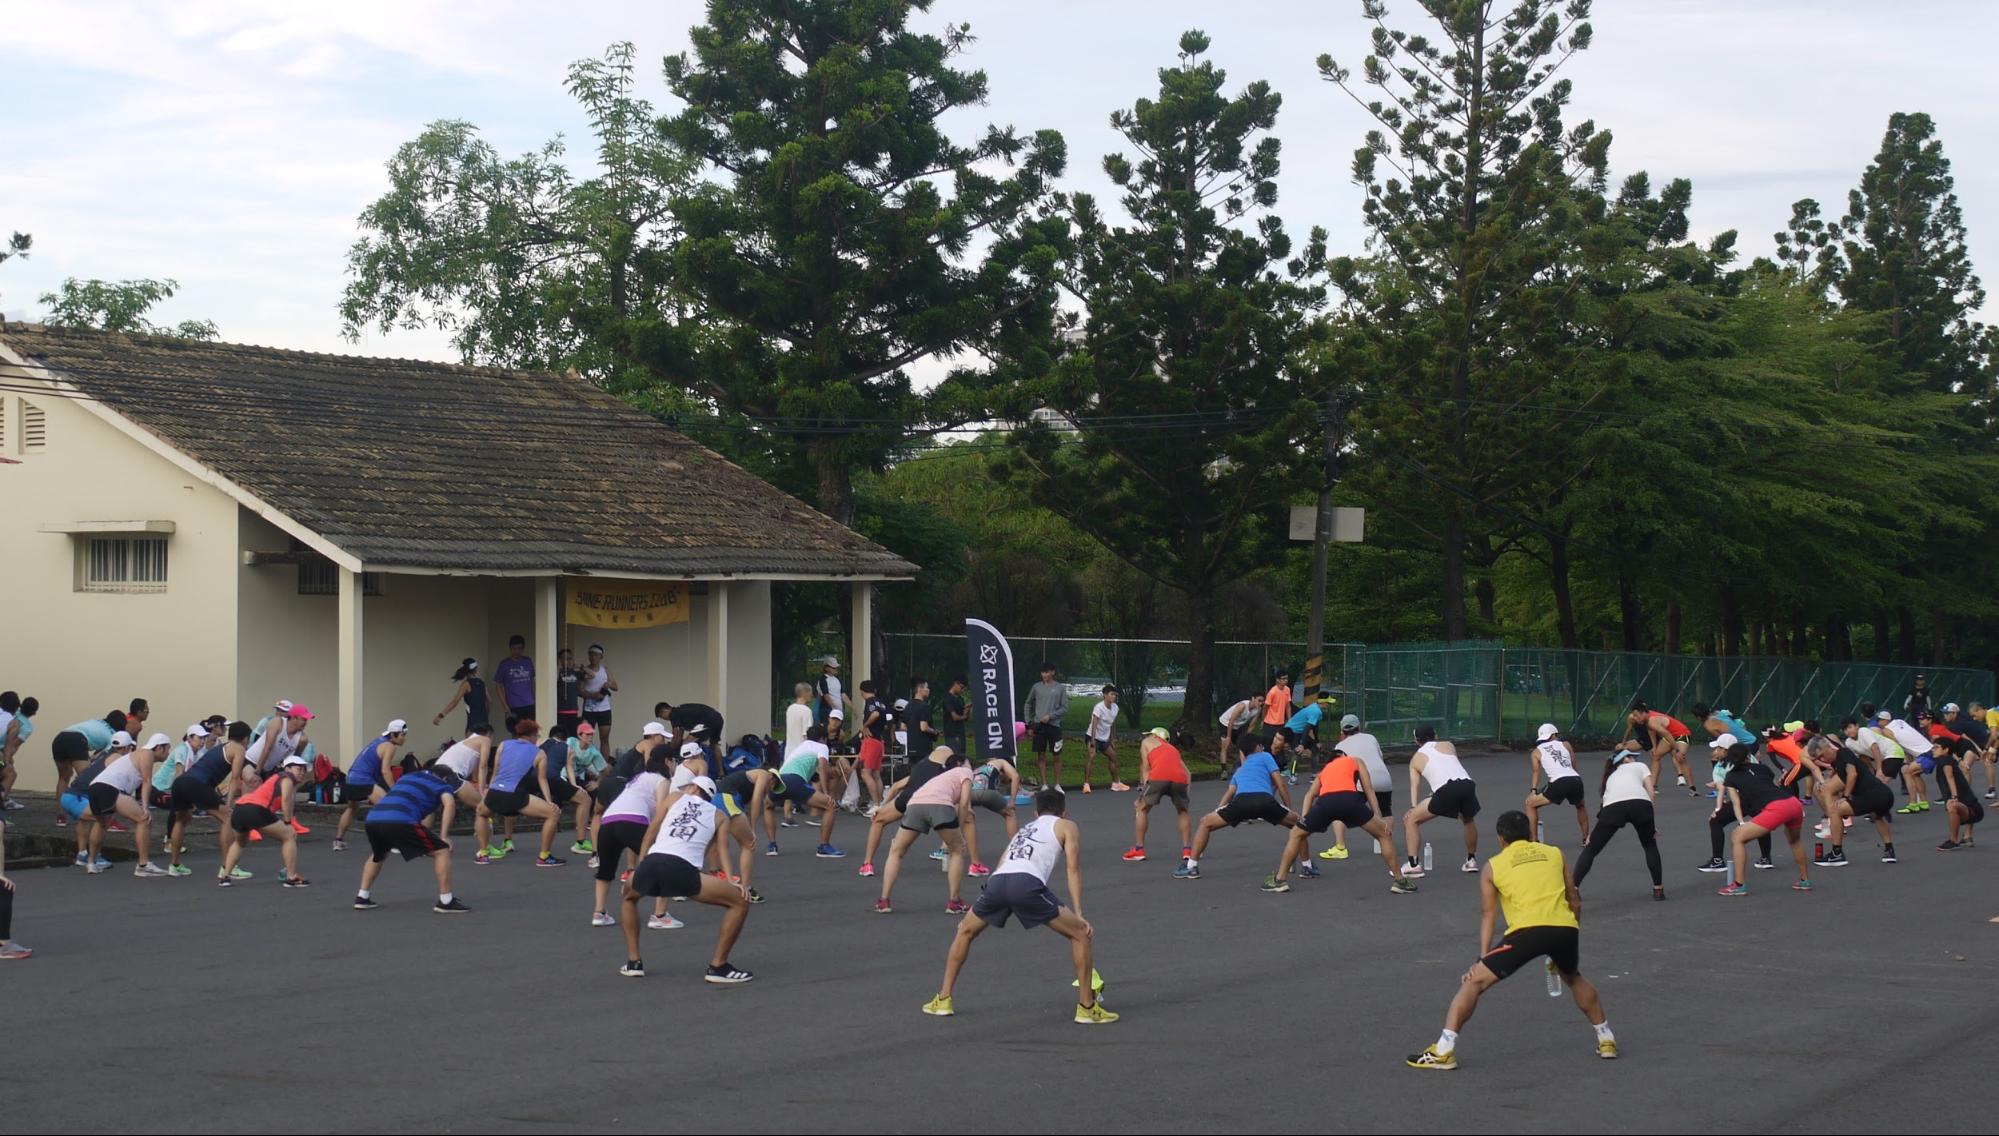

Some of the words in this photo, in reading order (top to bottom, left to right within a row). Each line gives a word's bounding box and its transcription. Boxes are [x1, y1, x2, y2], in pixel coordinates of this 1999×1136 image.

[602, 593, 649, 611] RUNNERS
[982, 668, 999, 718] RACE
[987, 721, 1003, 750] ON
